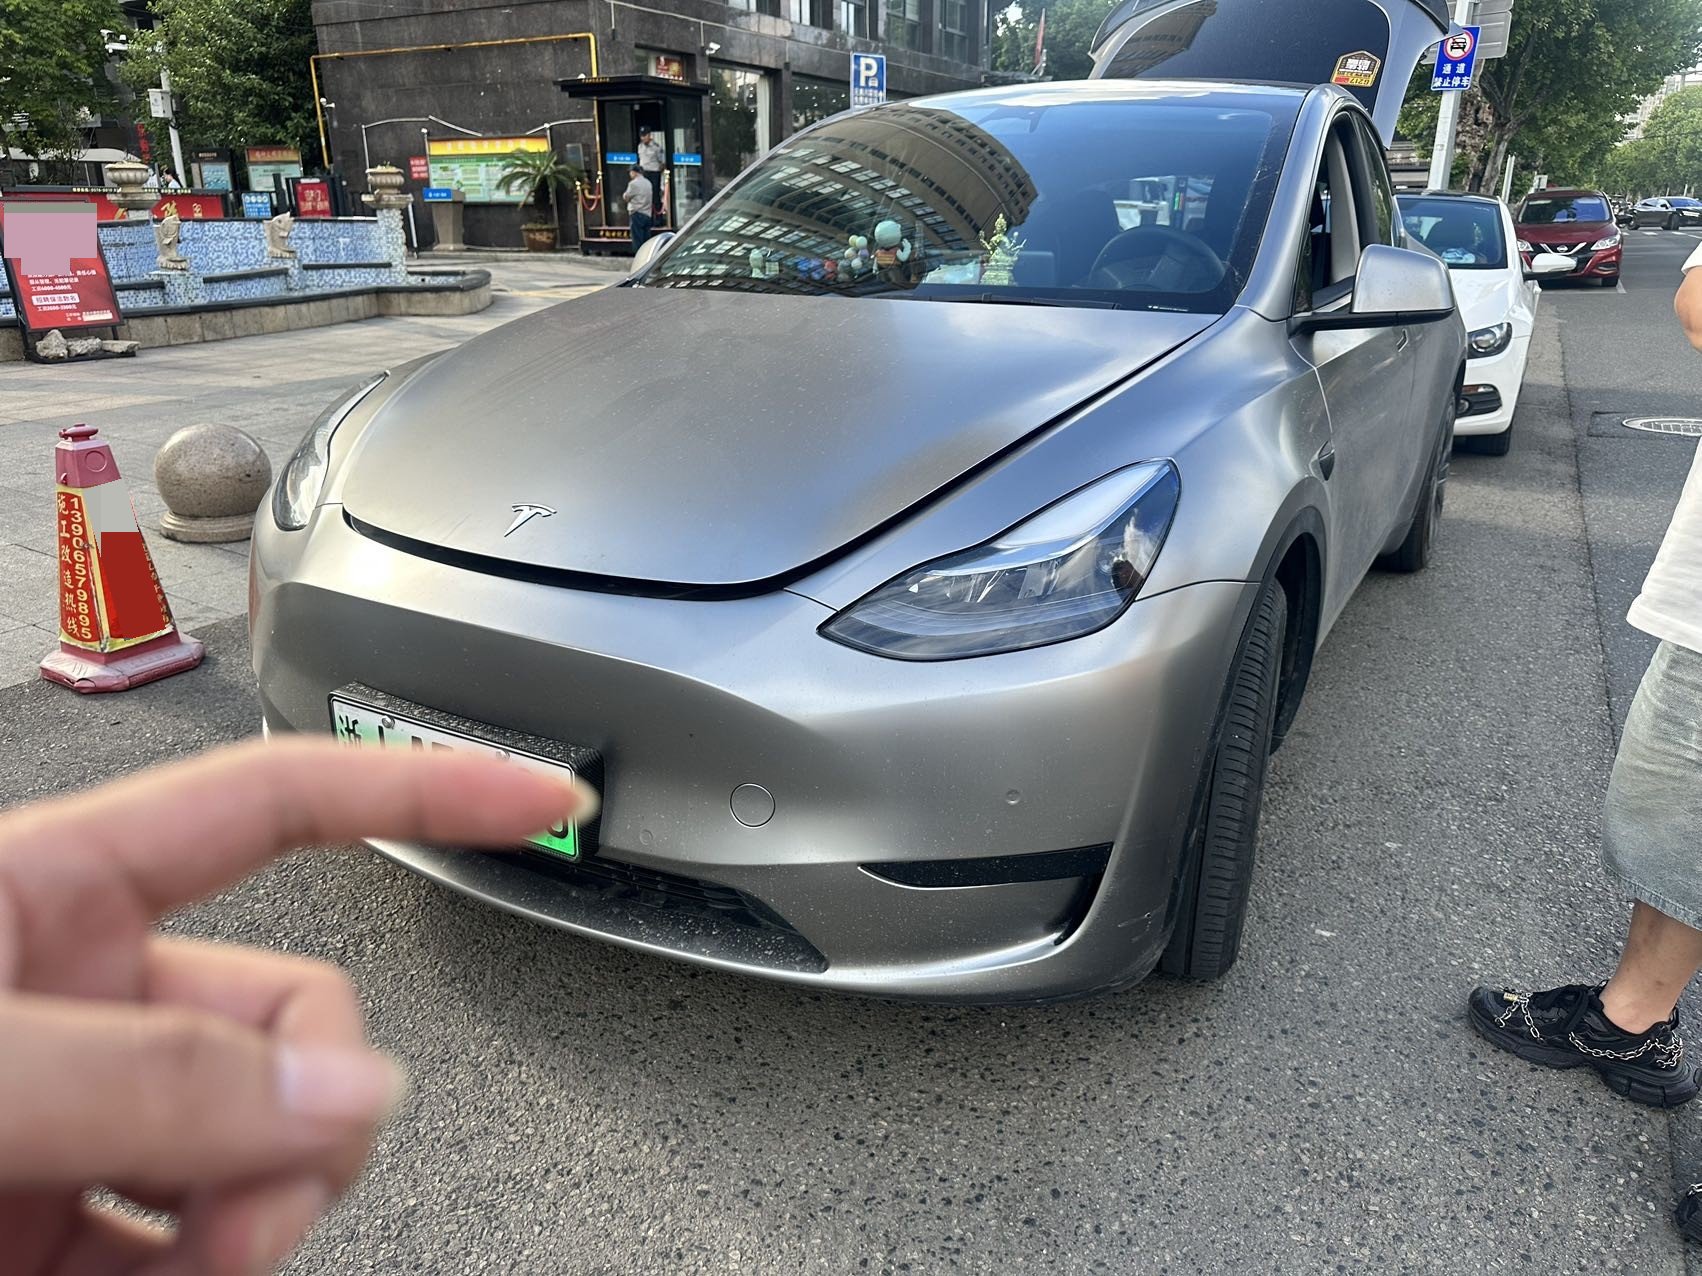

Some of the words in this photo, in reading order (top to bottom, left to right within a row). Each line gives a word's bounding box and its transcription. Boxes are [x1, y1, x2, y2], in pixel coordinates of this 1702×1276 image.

[860, 57, 877, 87] P
[1442, 63, 1465, 74] 通道
[1433, 76, 1470, 87] 禁止停车
[70, 497, 92, 639] 13906579895
